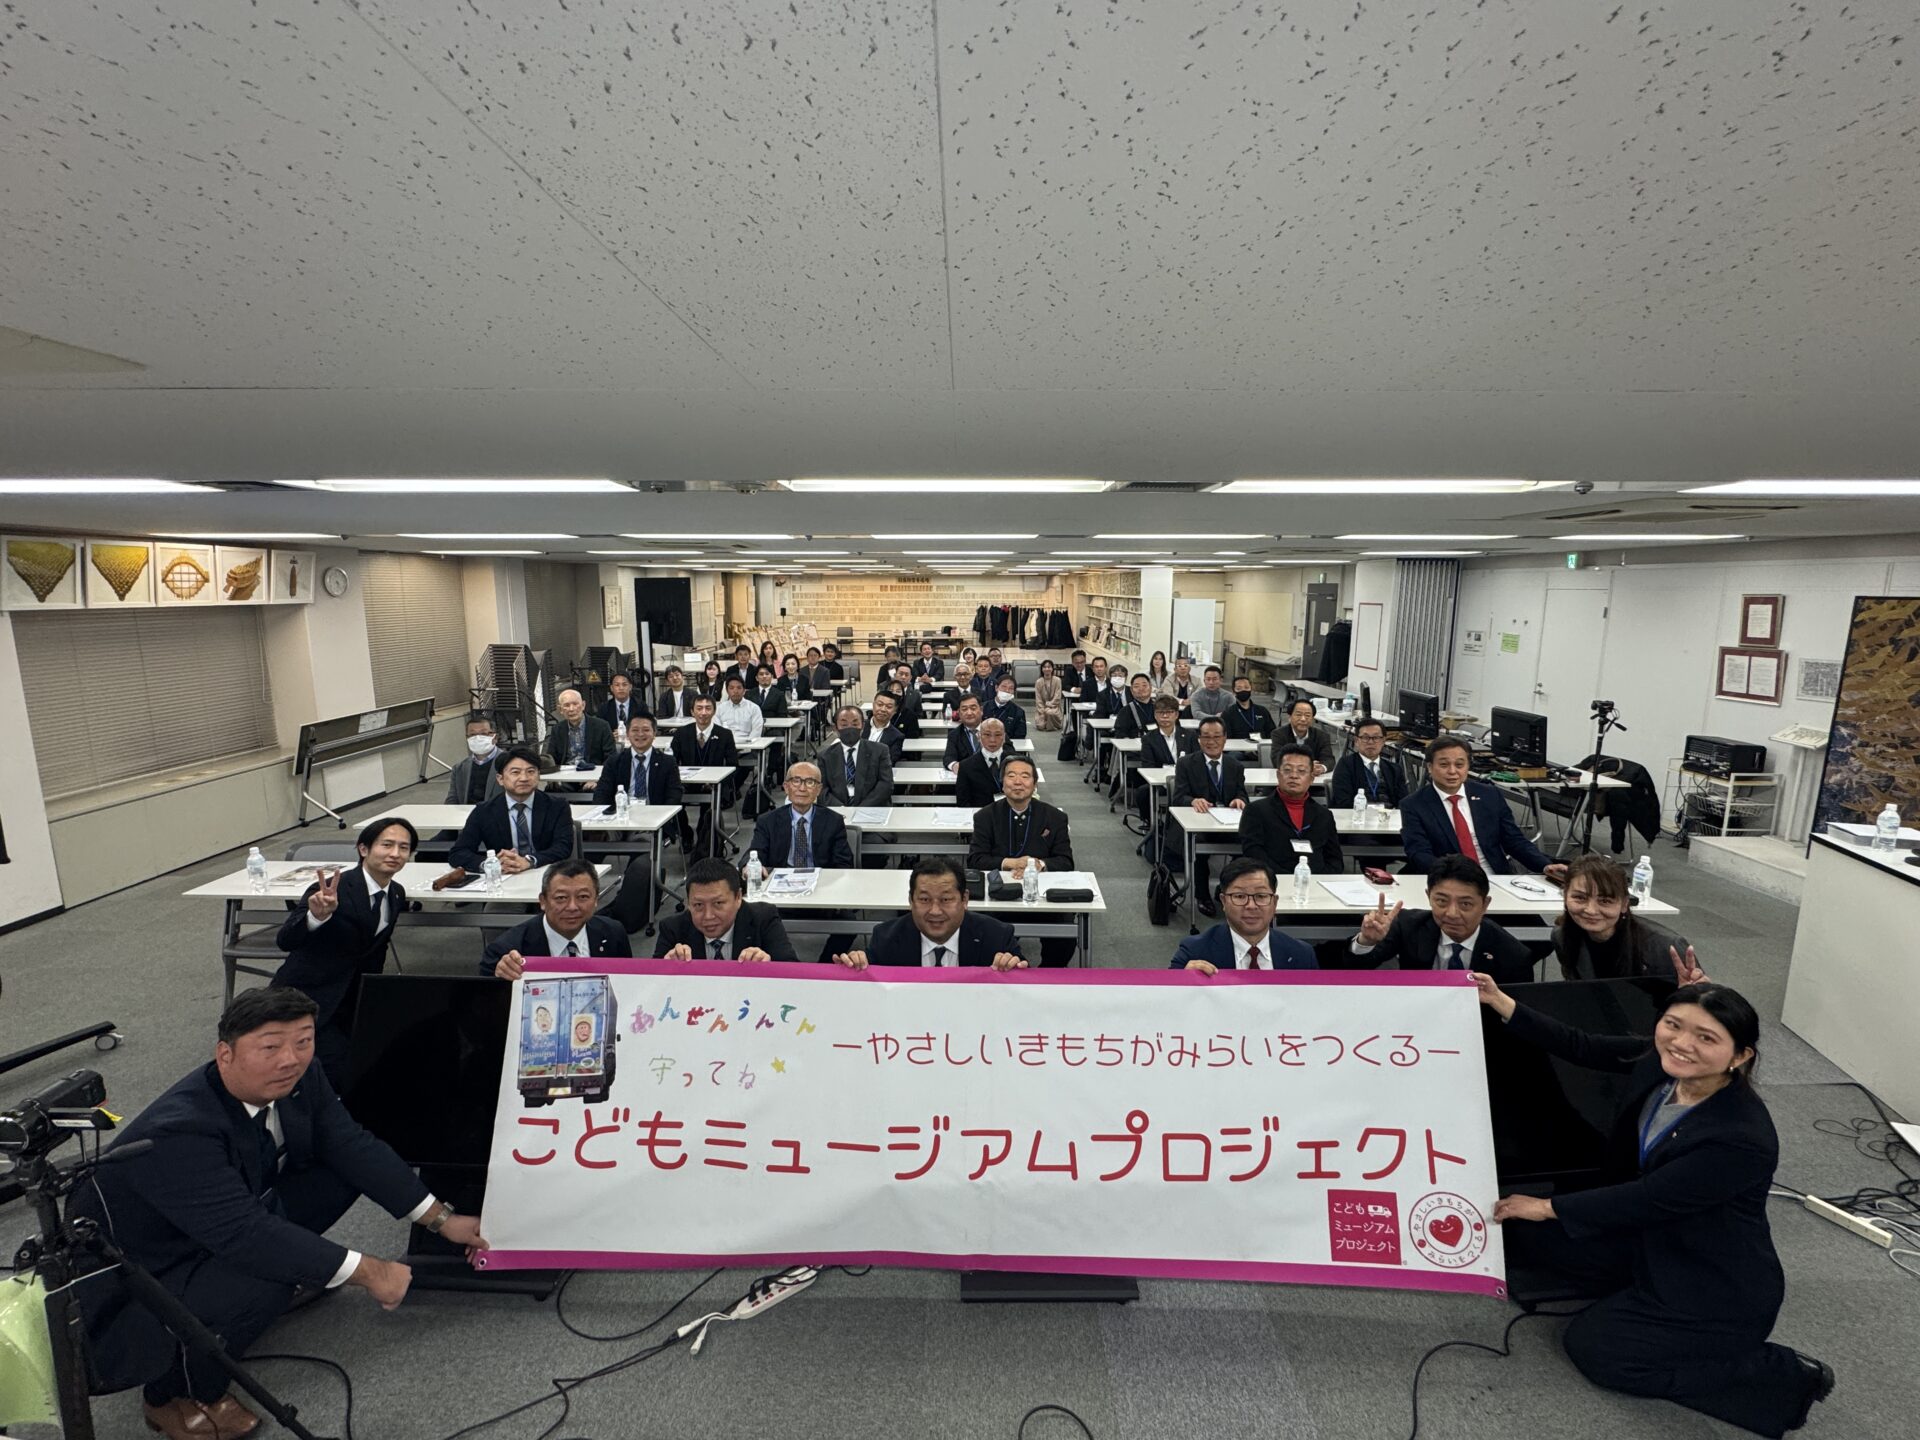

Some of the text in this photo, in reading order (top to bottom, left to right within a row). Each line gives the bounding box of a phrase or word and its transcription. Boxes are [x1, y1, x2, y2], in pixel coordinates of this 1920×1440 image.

[629, 995, 817, 1036] あんぜんうんてん
[649, 1054, 757, 1090] 守ってね
[511, 1108, 1468, 1185] こどもミュージアムプロジェクト
[1333, 1201, 1366, 1216] こども
[1334, 1219, 1395, 1235] ミュージアム
[1335, 1237, 1397, 1255] プロジェクト
